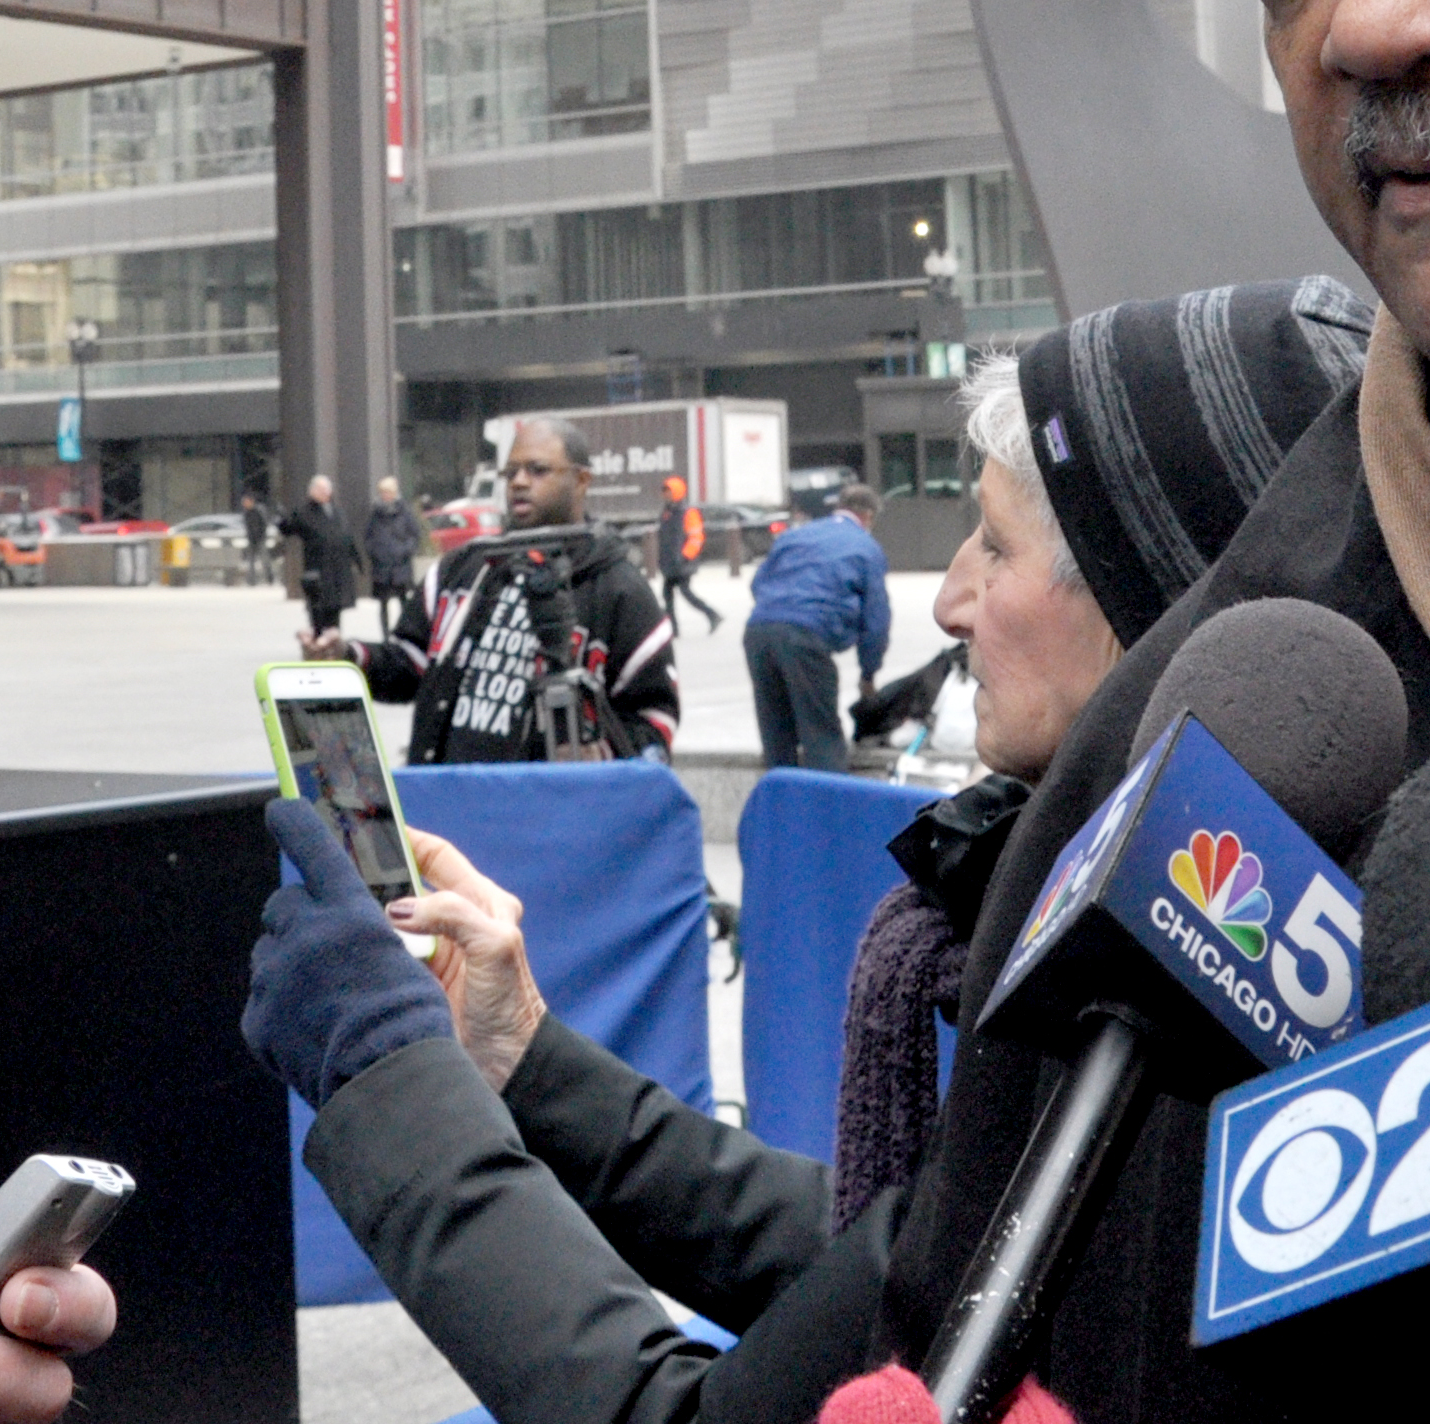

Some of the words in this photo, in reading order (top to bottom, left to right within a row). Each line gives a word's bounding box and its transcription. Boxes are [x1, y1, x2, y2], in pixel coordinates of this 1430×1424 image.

[627, 444, 674, 474] Roll
[1150, 897, 1277, 1032] CHICAGO
[1271, 872, 1363, 1028] 5
